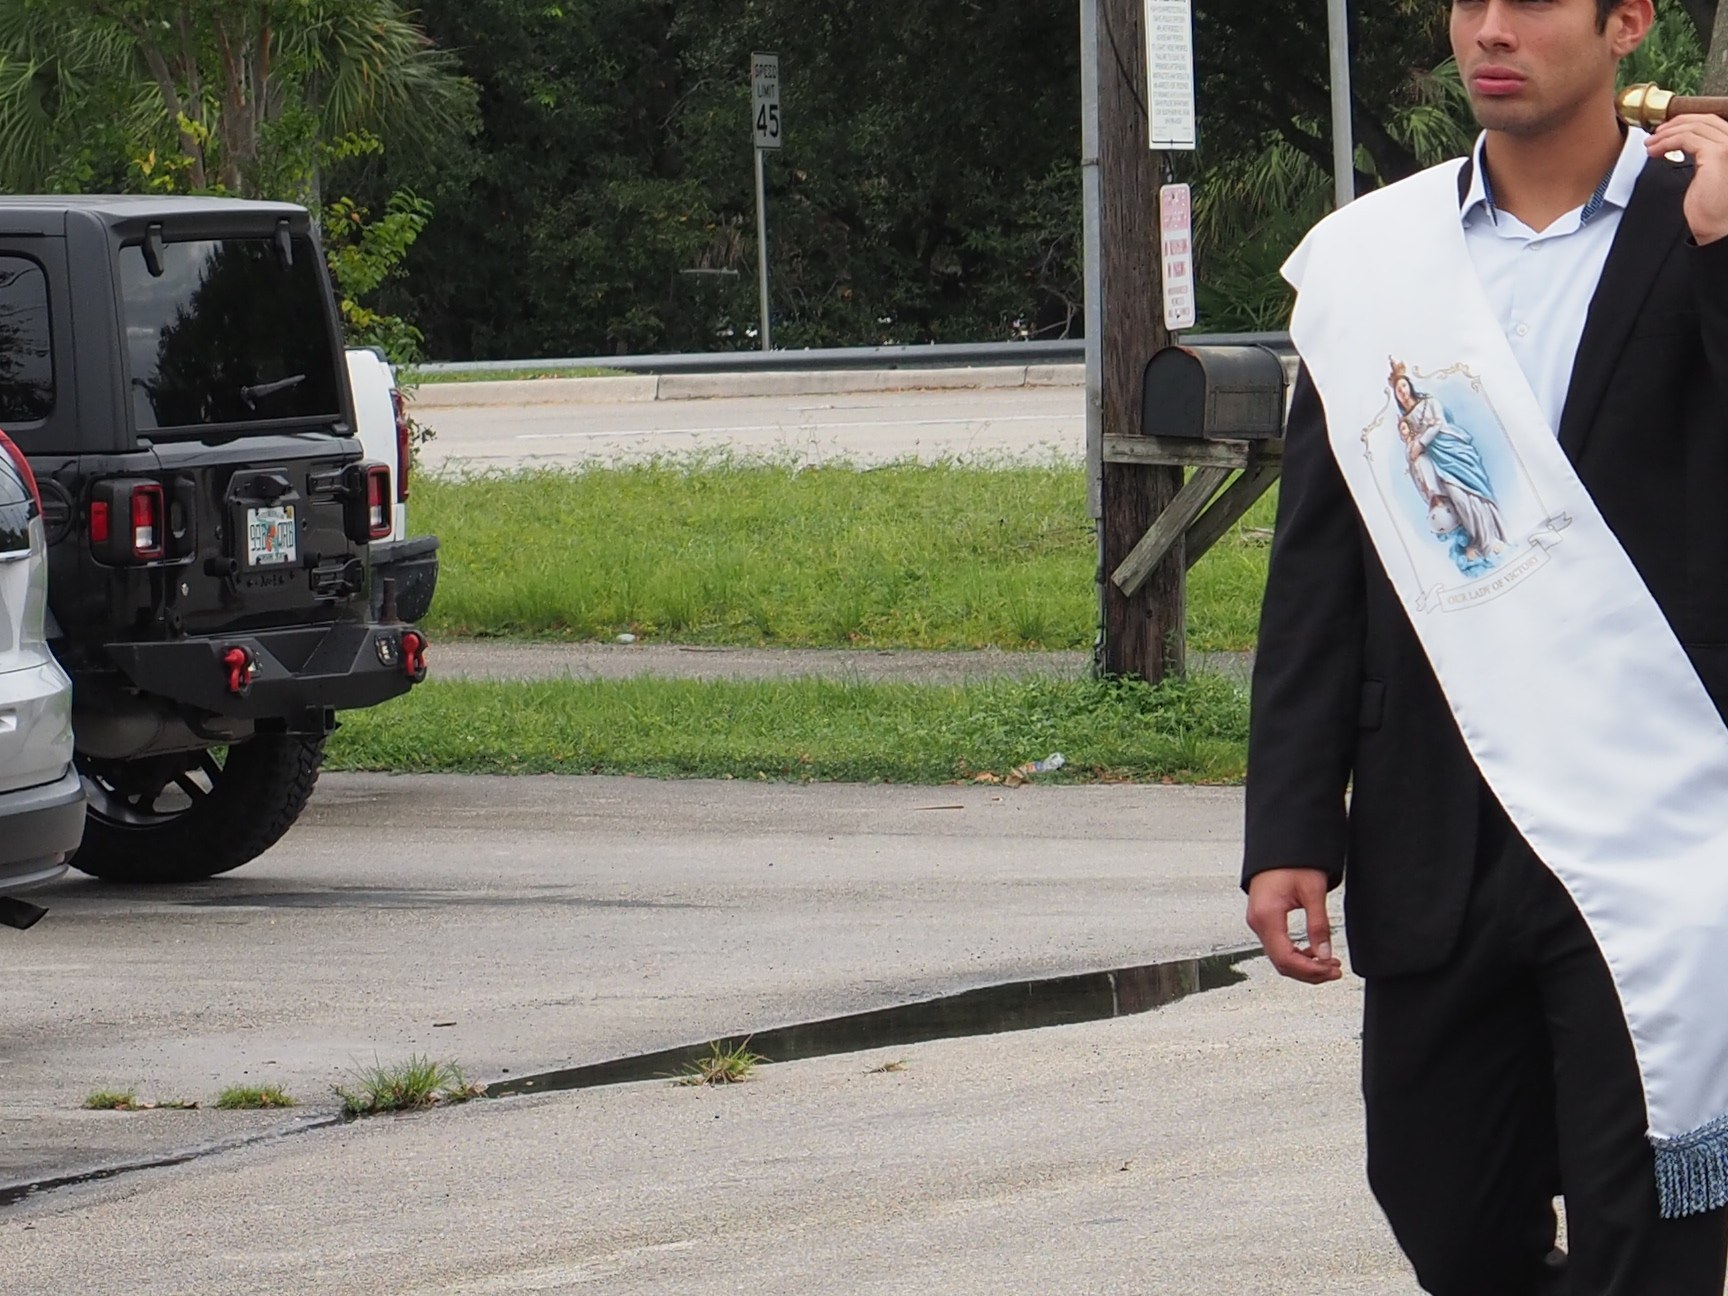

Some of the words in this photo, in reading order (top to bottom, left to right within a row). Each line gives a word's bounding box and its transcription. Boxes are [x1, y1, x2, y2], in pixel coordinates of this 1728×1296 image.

[755, 64, 776, 79] SPEED
[757, 84, 775, 98] LIMIT
[757, 104, 779, 138] 45
[1447, 593, 1469, 605] OUR
[1468, 586, 1491, 600] LADY
[1491, 579, 1504, 591] OF
